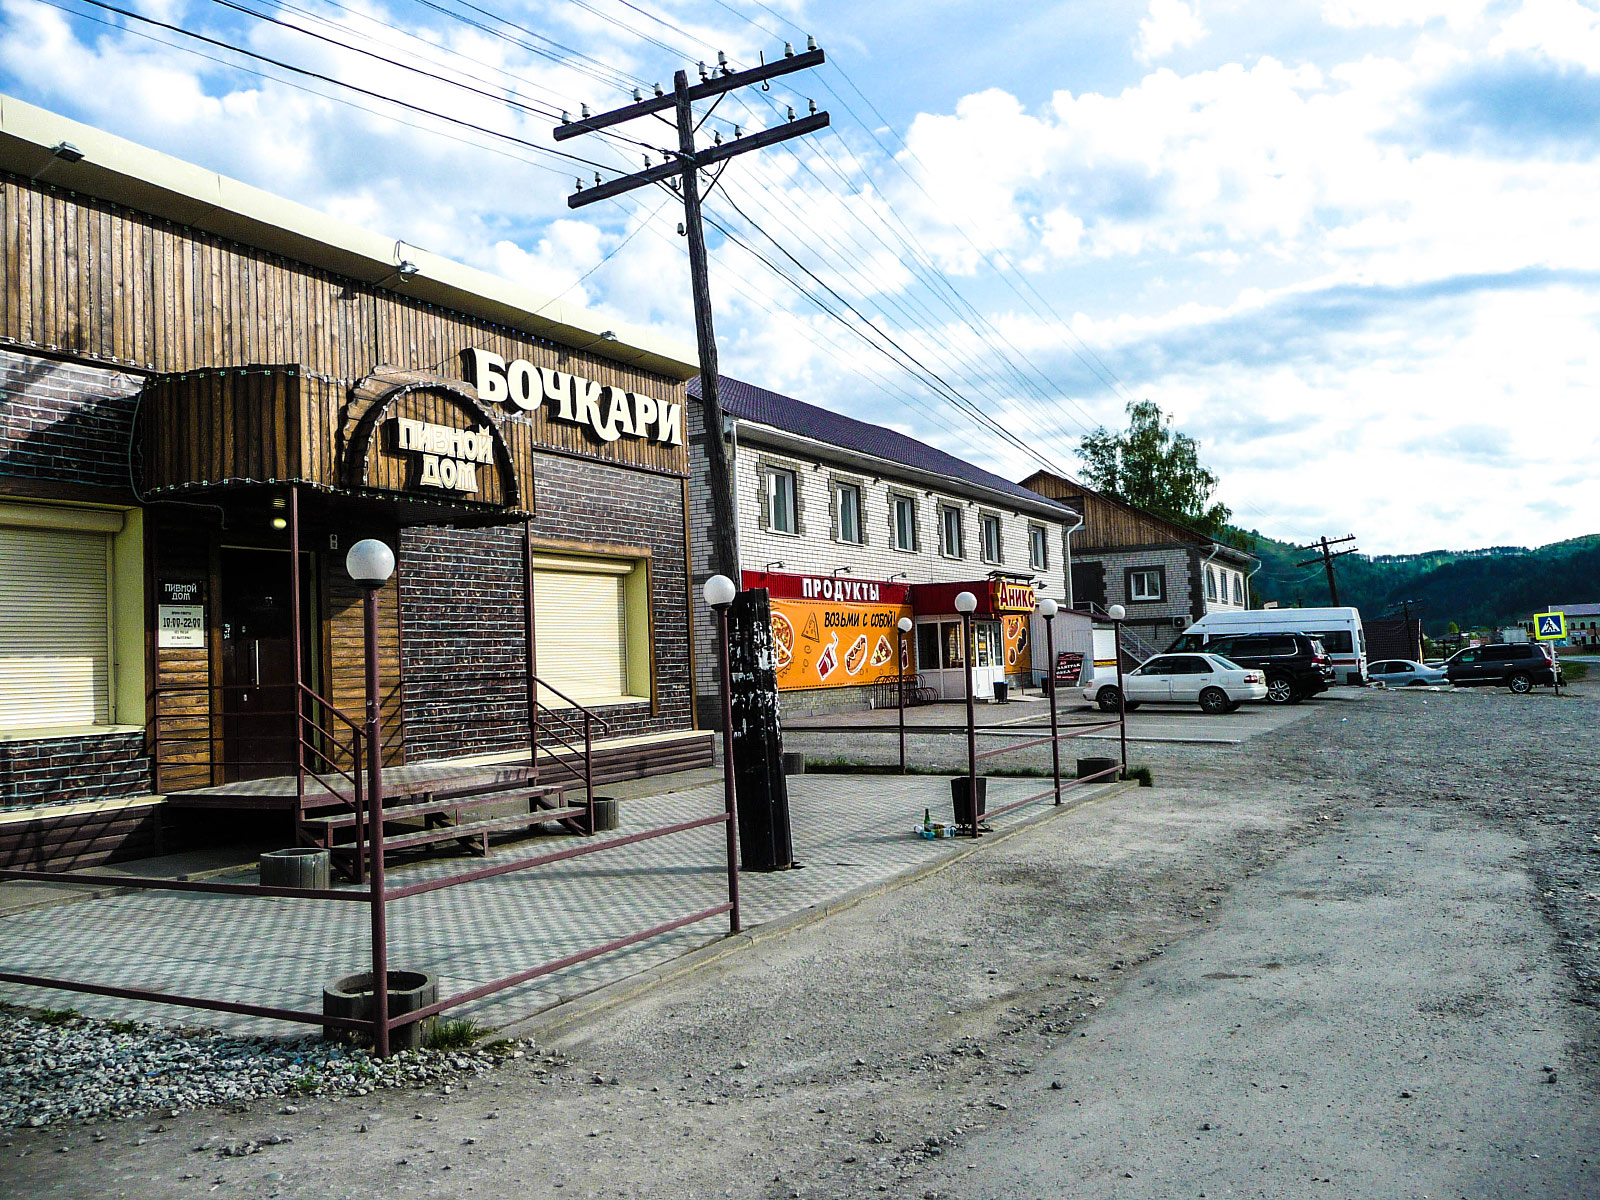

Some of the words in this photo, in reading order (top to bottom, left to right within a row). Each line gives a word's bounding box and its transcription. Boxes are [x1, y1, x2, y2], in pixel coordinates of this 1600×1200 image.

[470, 346, 683, 446] БОЧКАРИ
[397, 416, 494, 465] ПИВНОЙ
[420, 453, 478, 493] ДОМ
[164, 583, 197, 593] ПИВНОЙ
[171, 592, 191, 601] ДОМ
[802, 577, 880, 602] ПРОДУКТЫ
[824, 611, 860, 628] ВОЗЬМИ
[863, 613, 868, 626] С
[870, 610, 896, 628] СОБОЙ!
